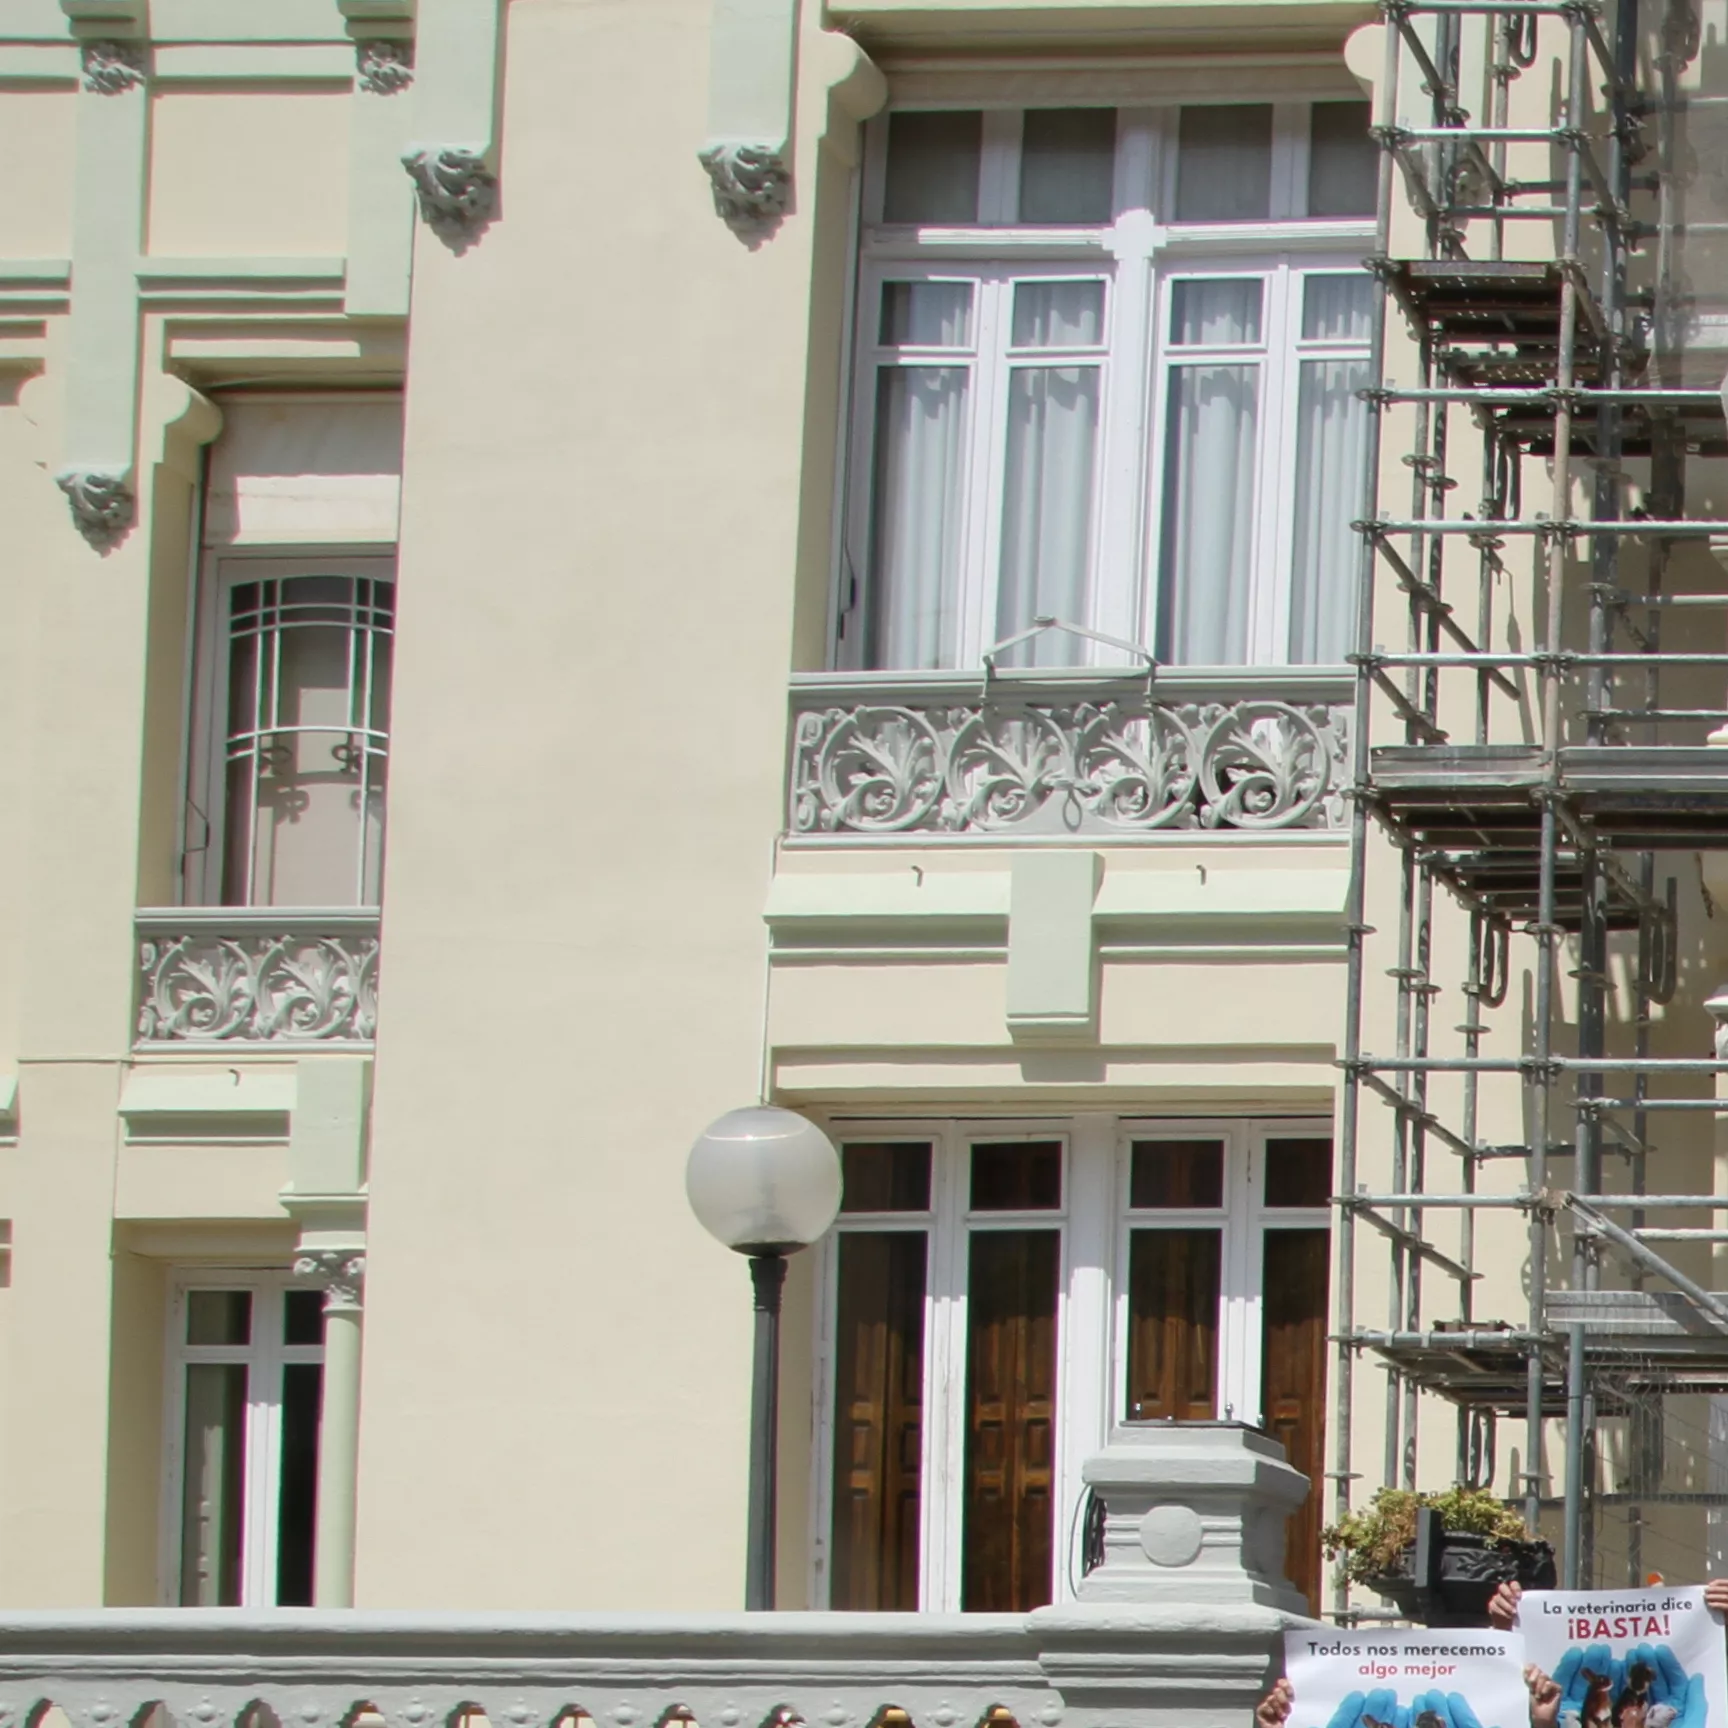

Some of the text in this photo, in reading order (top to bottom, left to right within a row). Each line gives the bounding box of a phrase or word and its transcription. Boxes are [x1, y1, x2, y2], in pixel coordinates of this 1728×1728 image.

[1543, 1597, 1692, 1614] La veterinaria dice
[1568, 1615, 1671, 1639] ¡BASTA!
[1308, 1641, 1506, 1656] Todos nos merecemos
[1359, 1660, 1457, 1679] algo mejor
